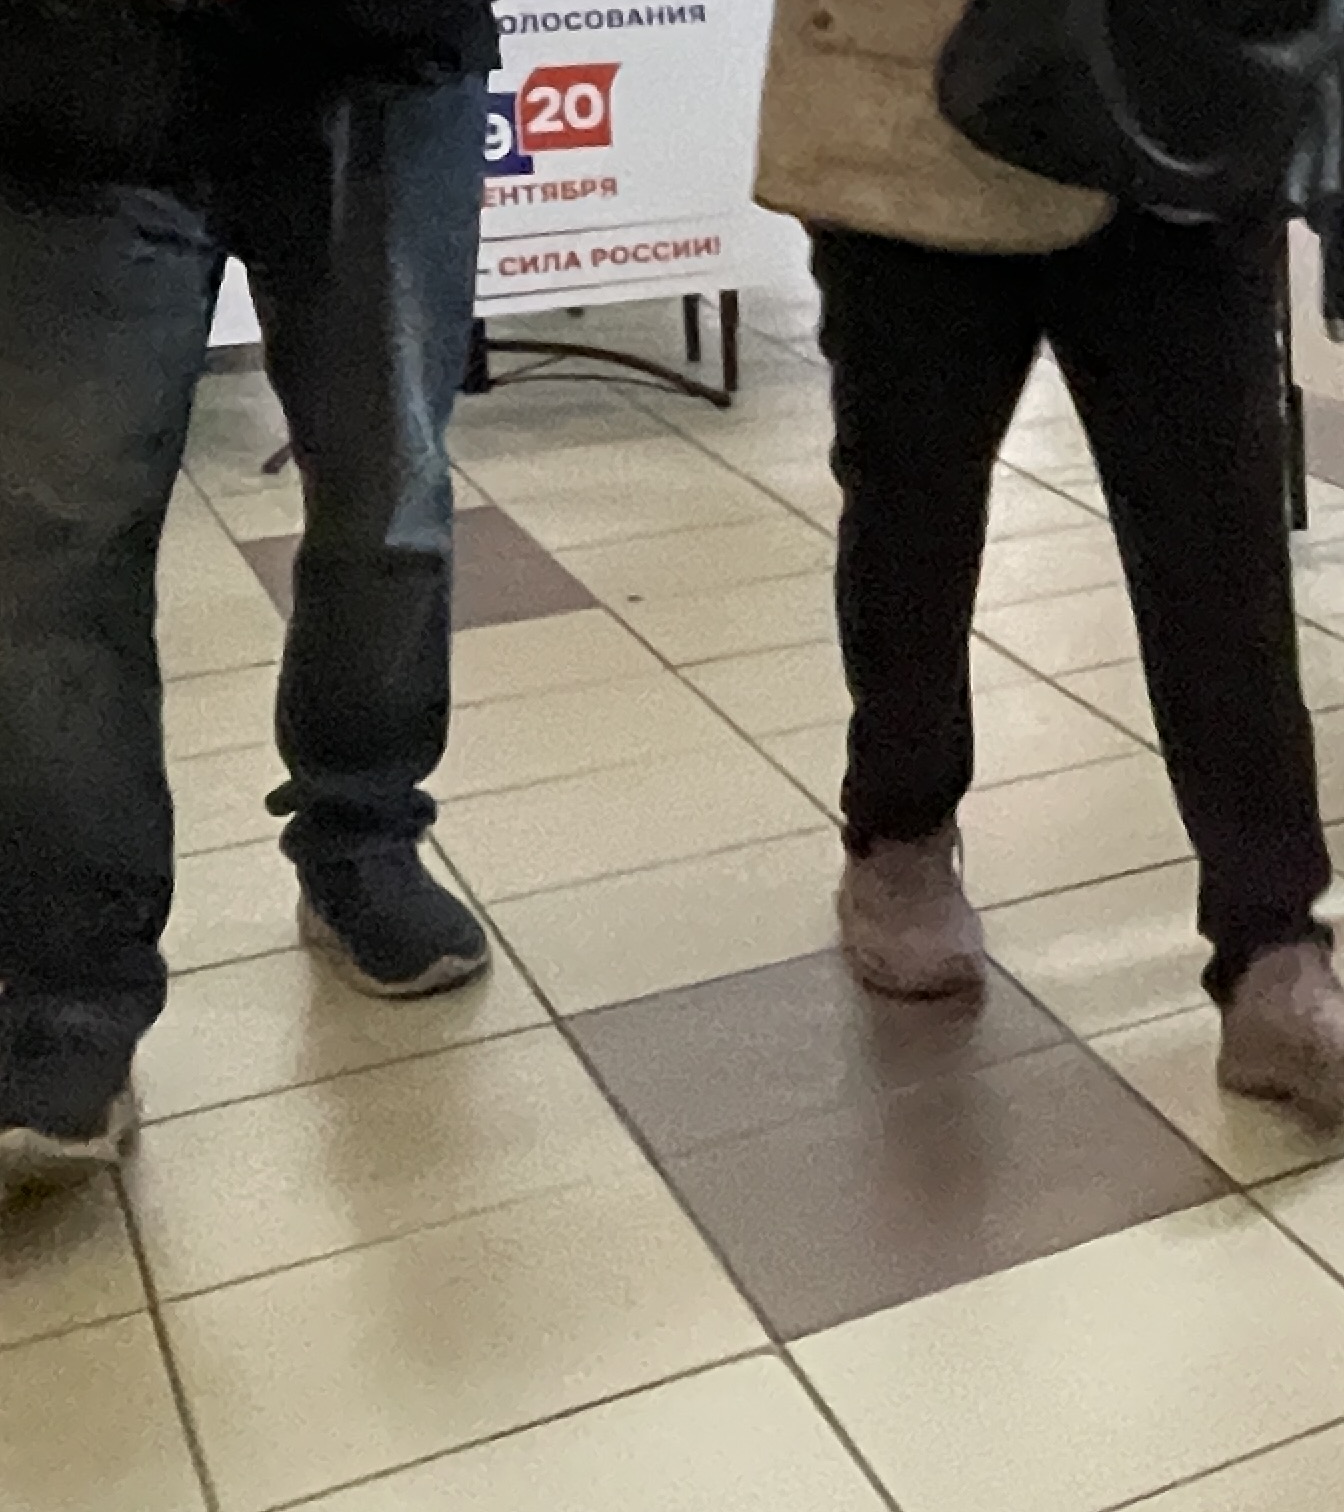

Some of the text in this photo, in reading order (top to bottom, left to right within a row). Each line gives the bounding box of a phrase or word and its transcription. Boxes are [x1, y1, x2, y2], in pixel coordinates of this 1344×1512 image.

[499, 4, 706, 35] ОЛОСОВАНИЯ
[483, 82, 604, 162] 9 20
[483, 177, 618, 208] ЕНТЯБРЯ
[499, 250, 581, 277] СИЛА
[591, 235, 721, 267] РОССИИ!
